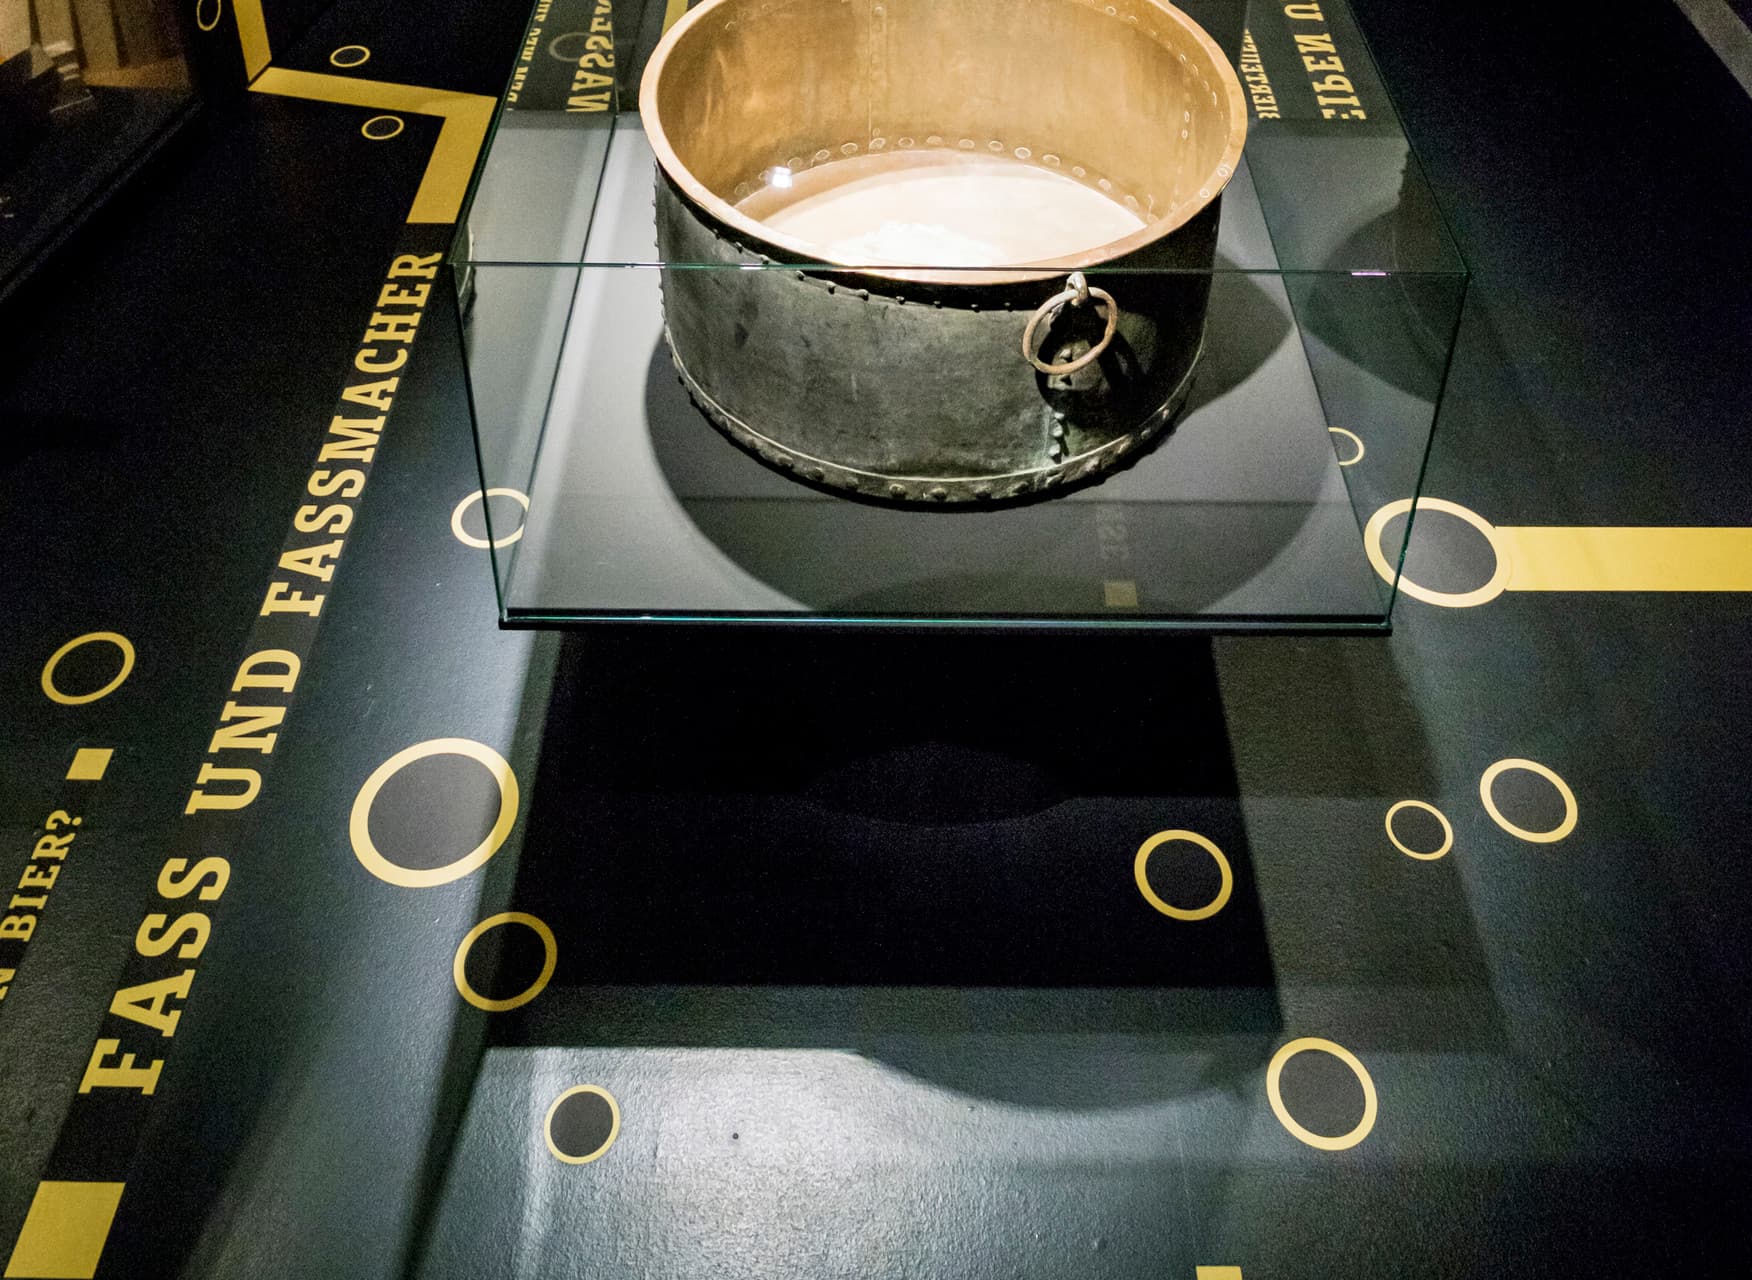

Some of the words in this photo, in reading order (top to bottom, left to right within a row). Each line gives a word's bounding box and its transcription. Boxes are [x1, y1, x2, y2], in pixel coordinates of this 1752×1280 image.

[0, 810, 82, 942] BIER?
[78, 856, 230, 1096] FASS
[185, 649, 301, 815] UND
[260, 251, 443, 618] FASSMACHER
